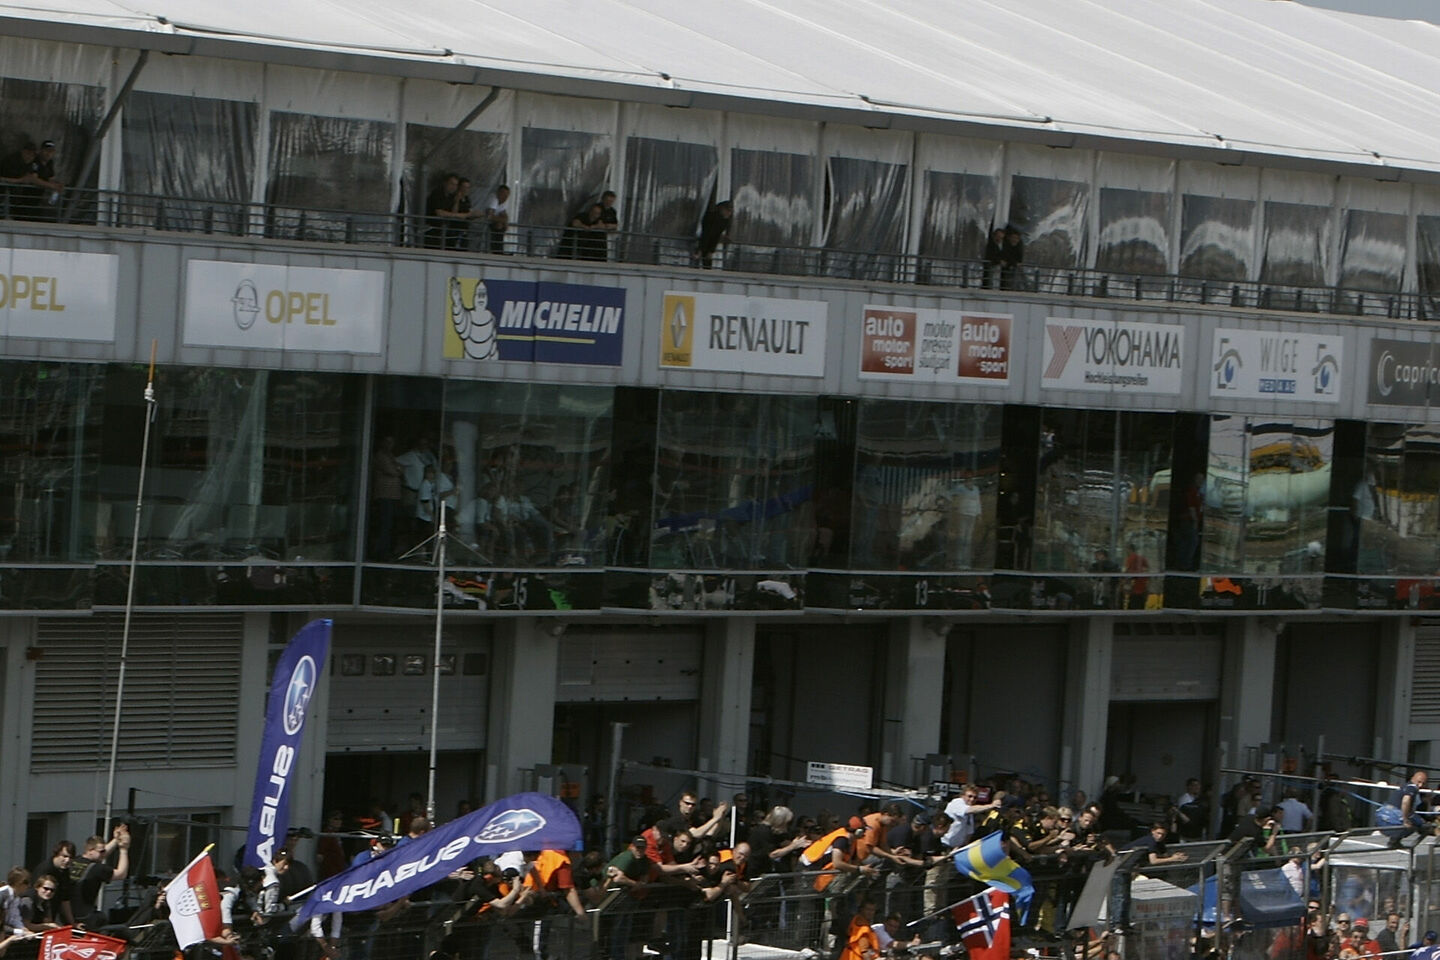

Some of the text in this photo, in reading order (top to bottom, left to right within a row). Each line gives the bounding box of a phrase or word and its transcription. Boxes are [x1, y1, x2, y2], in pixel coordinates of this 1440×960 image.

[265, 289, 338, 326] OPEL
[499, 300, 622, 334] MICHELIN
[708, 314, 810, 355] RENAULT
[865, 315, 905, 338] auto
[962, 321, 1000, 343] auto
[871, 338, 910, 354] motor
[968, 344, 1005, 359] motor
[1084, 327, 1181, 369] YOKOHAMA
[1260, 337, 1298, 373] WIGE
[884, 354, 913, 369] sport
[980, 359, 1007, 374] sport
